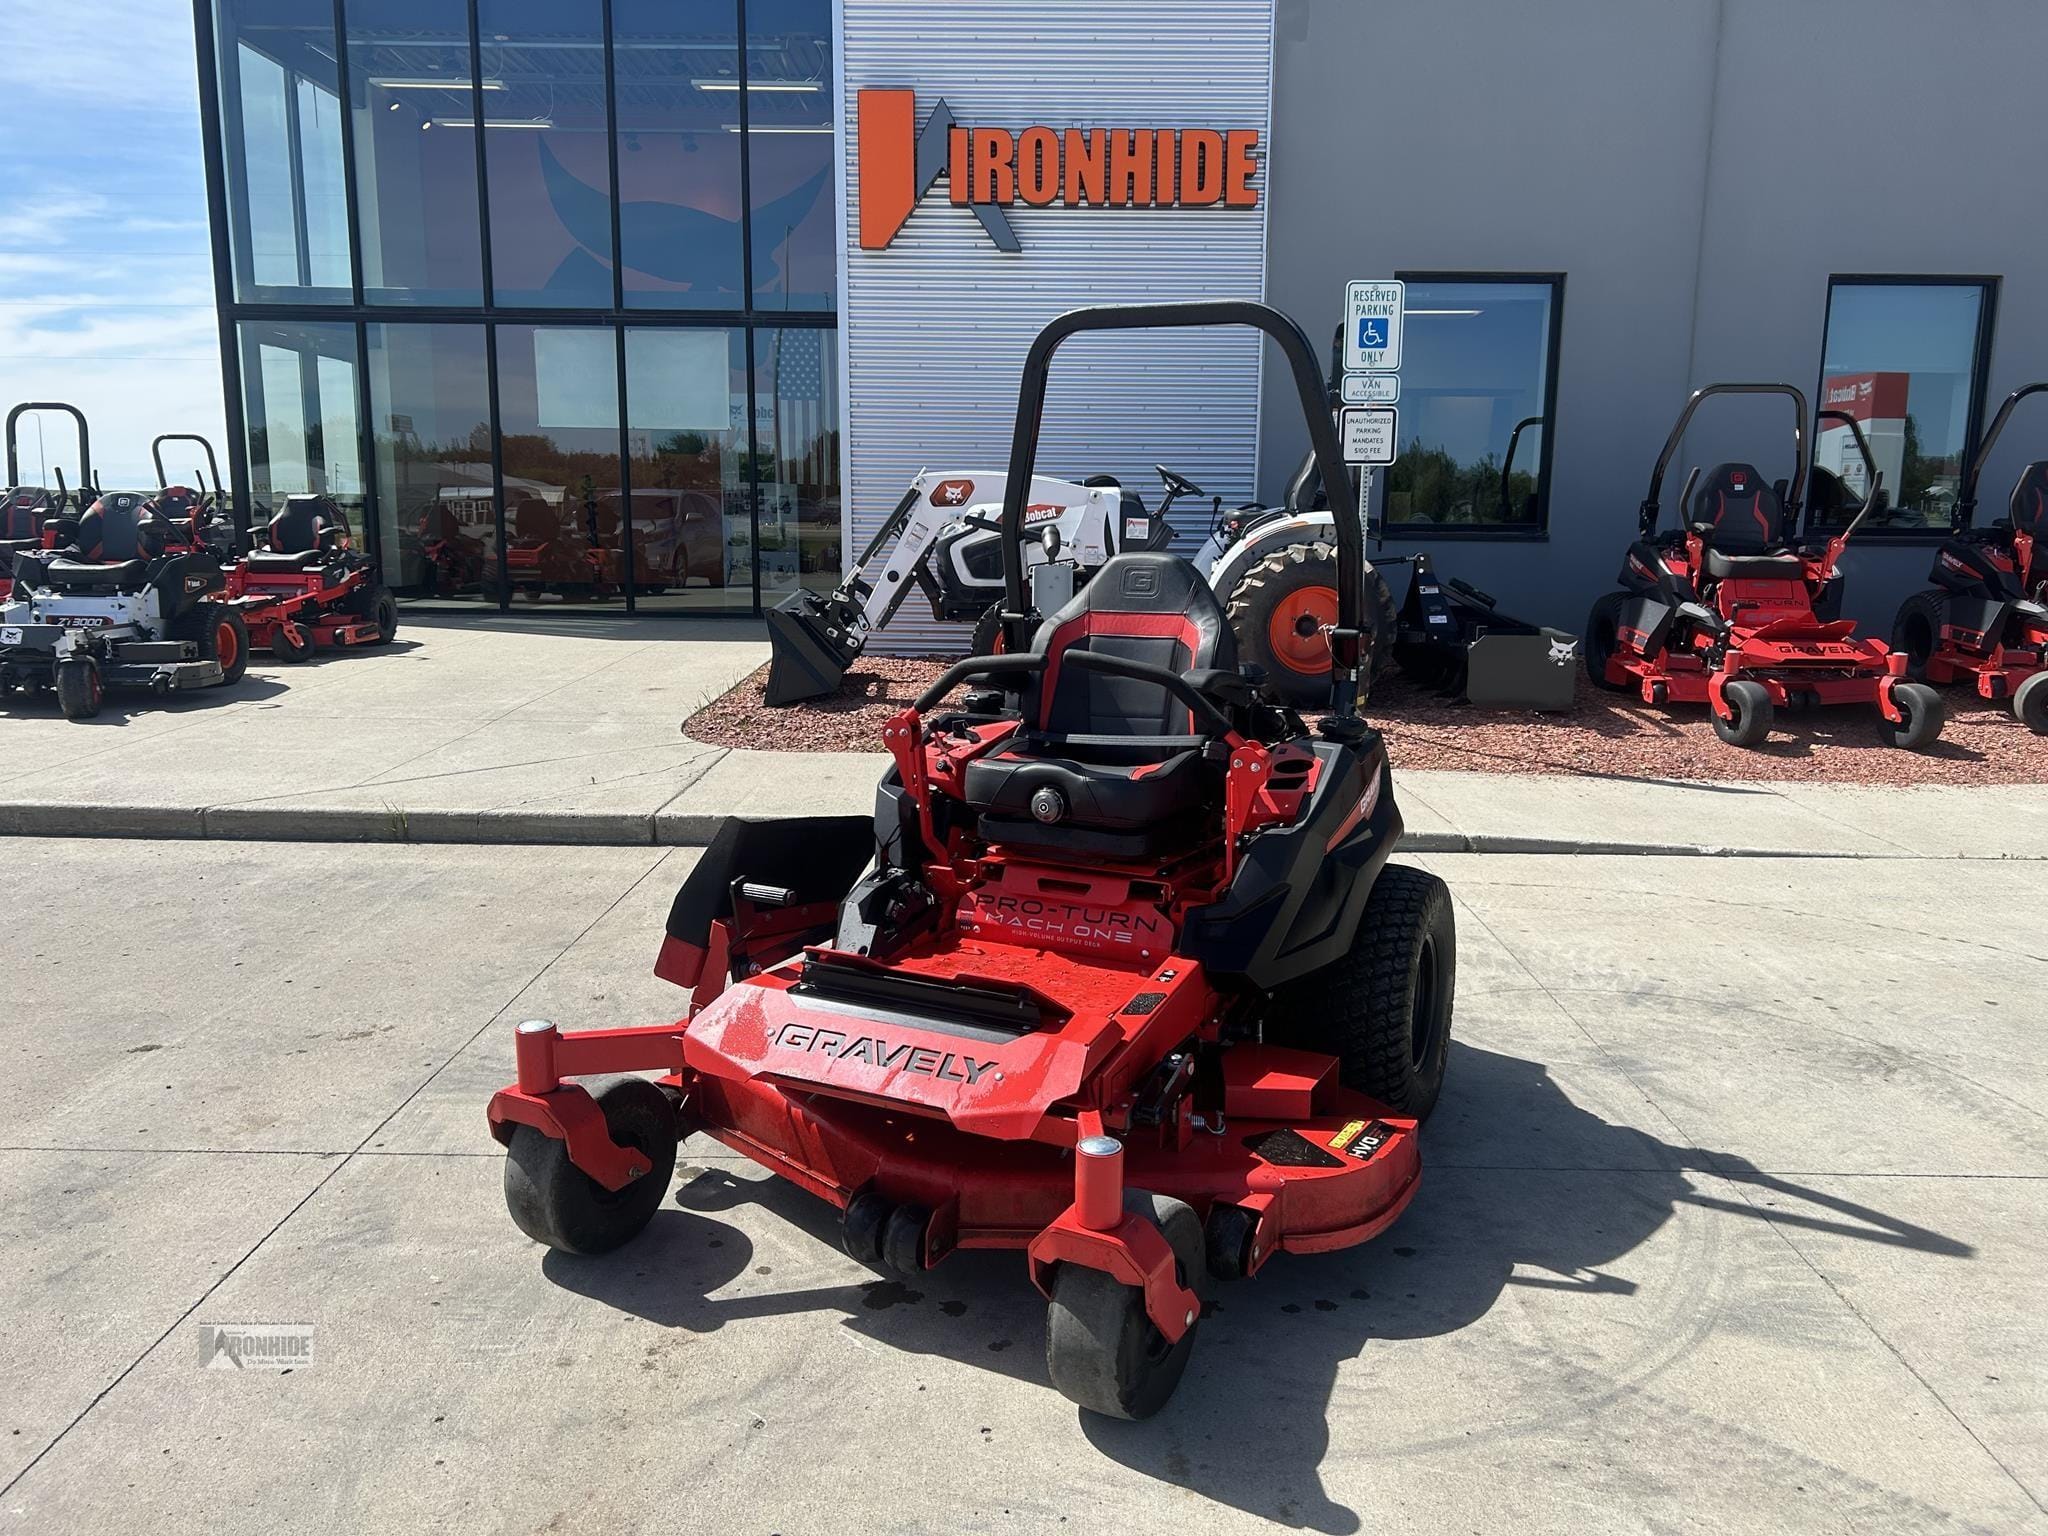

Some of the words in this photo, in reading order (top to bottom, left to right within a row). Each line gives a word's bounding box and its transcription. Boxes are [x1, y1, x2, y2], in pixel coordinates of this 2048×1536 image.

[948, 125, 1259, 208] IRONHIDE
[1353, 290, 1397, 302] RESERVED
[1355, 304, 1394, 316] PARKING
[1361, 351, 1384, 362] ONLY
[1361, 380, 1381, 389] VAN
[1346, 417, 1392, 425] UNAUTHORIZED
[1025, 507, 1057, 523] Bobcat
[1778, 645, 1862, 655] GRAVELY
[975, 894, 1158, 932] PRO-TURN
[985, 912, 1064, 934] MACH
[1073, 925, 1133, 944] ONE
[1011, 929, 1055, 941] HIGH-VOLUME
[1056, 936, 1083, 945] OUTPUT
[775, 1023, 999, 1085] GRAVELY
[1347, 1136, 1380, 1159] HVO
